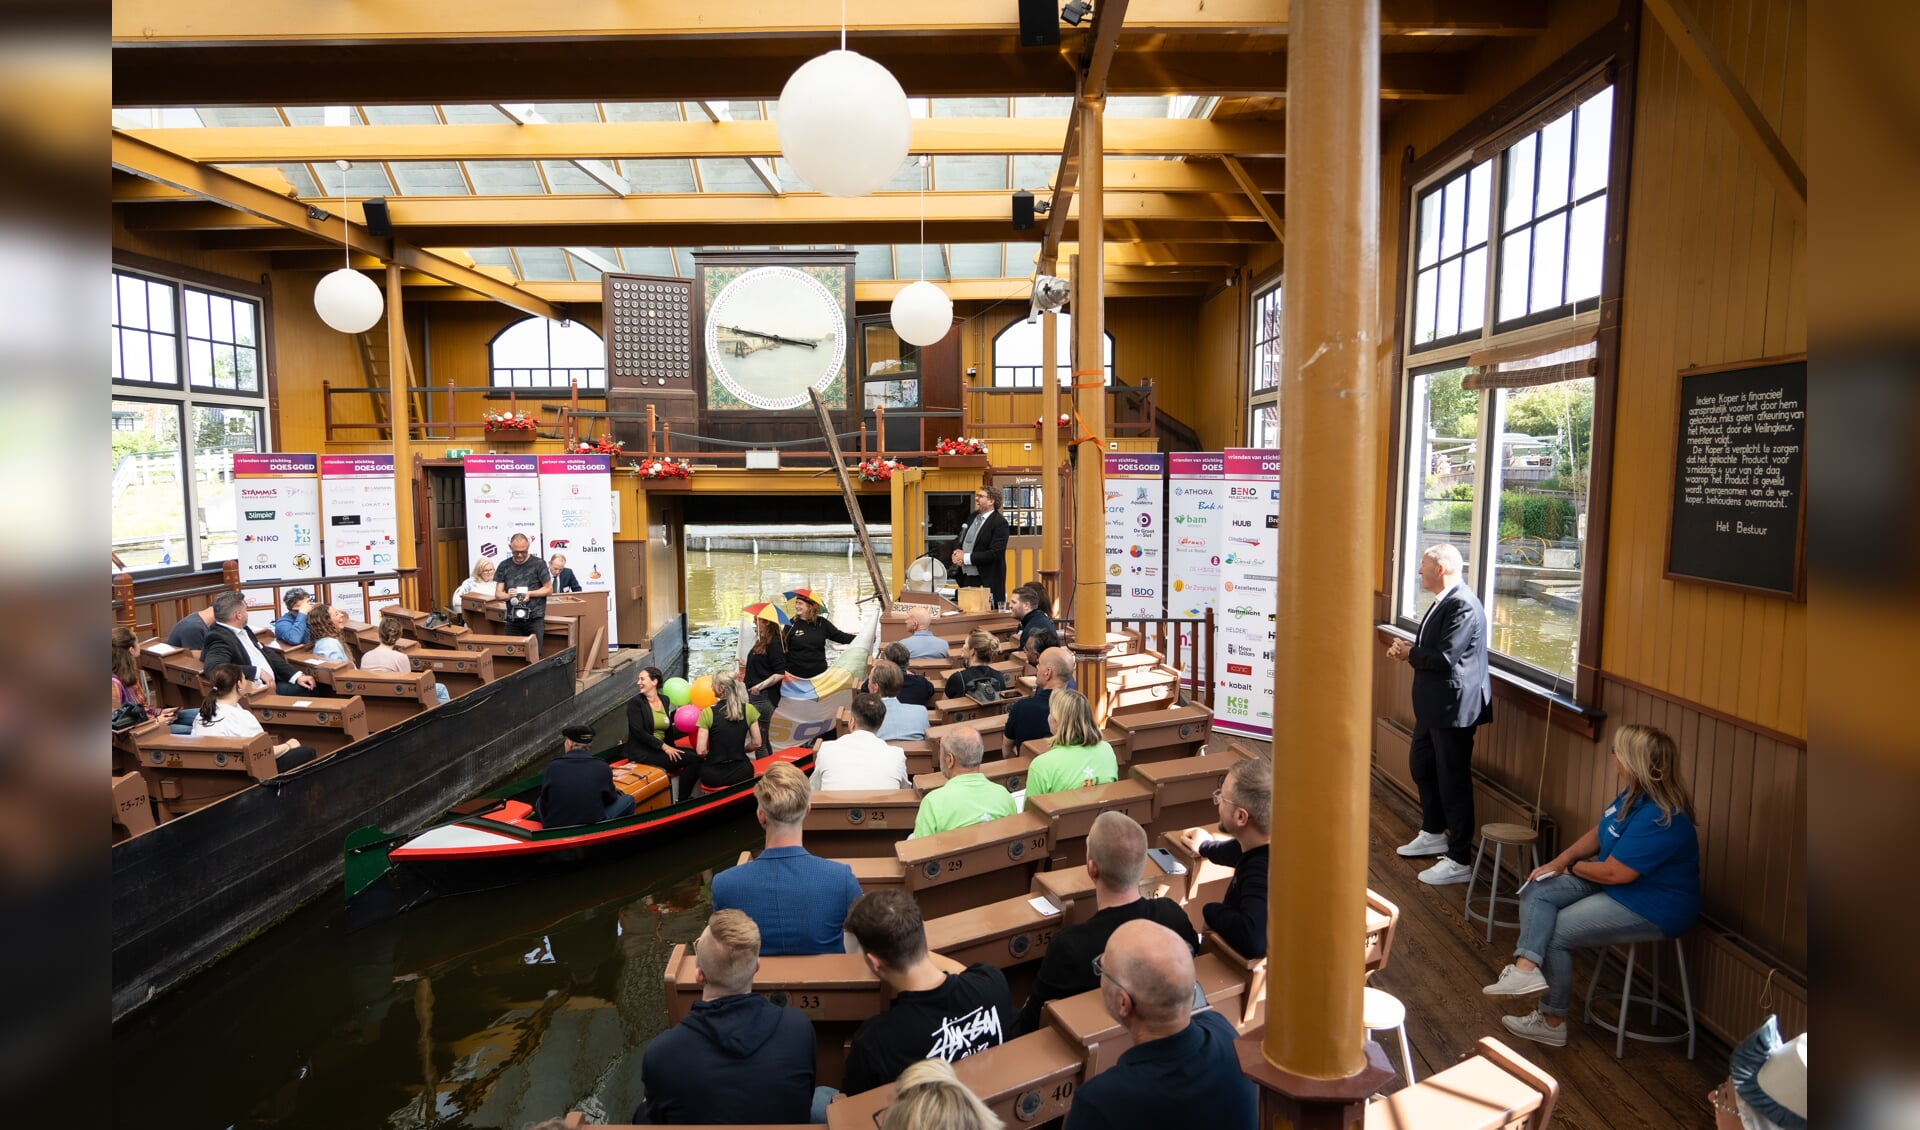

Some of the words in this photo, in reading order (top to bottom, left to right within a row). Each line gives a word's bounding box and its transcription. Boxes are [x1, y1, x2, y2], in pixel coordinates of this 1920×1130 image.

[1719, 394, 1739, 406] Koper
[1741, 393, 1746, 401] is
[1749, 388, 1783, 403] financieel
[1746, 401, 1758, 411] het
[1761, 401, 1777, 412] door
[1779, 399, 1797, 409] hem
[1736, 414, 1753, 427] geen
[1757, 411, 1789, 423] afkeuring
[1790, 411, 1804, 419] van
[1688, 425, 1698, 435] het
[1699, 423, 1723, 437] Product
[1727, 424, 1742, 436] door
[1743, 424, 1752, 433] de
[1687, 436, 1712, 444] meester
[1693, 446, 1702, 454] De
[1705, 445, 1724, 458] Koper
[1725, 445, 1730, 453] is
[1732, 444, 1760, 457] verplicht
[1763, 444, 1770, 453] te
[1773, 446, 1798, 456] zorgen
[1118, 457, 1138, 465] stichting
[1202, 457, 1223, 465] stichting
[1709, 456, 1737, 466] gekochte
[1742, 454, 1768, 464] Product
[1725, 468, 1737, 476] uur
[1754, 465, 1763, 475] de
[1766, 466, 1780, 478] dag
[1685, 477, 1708, 487] waarop
[1711, 475, 1722, 483] het
[1725, 474, 1749, 484] Product
[1753, 476, 1758, 484] is
[1184, 489, 1214, 497] ATHORA
[1231, 487, 1257, 496] BENO
[1705, 488, 1747, 498] overgenomen
[1766, 487, 1774, 496] de
[1707, 495, 1741, 505] behoudens
[1187, 514, 1207, 524] bam
[1232, 520, 1252, 529] HUUB
[1716, 521, 1729, 531] Het
[1737, 521, 1767, 535] Bestuur
[337, 556, 357, 566] otto
[1134, 588, 1154, 597] BDO
[1229, 681, 1253, 692] kobalt
[277, 711, 288, 719] 68
[169, 753, 181, 762] 73
[120, 794, 146, 813] 75-79
[871, 811, 886, 822] 23
[1031, 837, 1045, 851] 30
[947, 859, 964, 873] 29
[1034, 932, 1051, 947] 35
[799, 995, 820, 1010] 33
[1050, 1081, 1073, 1103] 40
